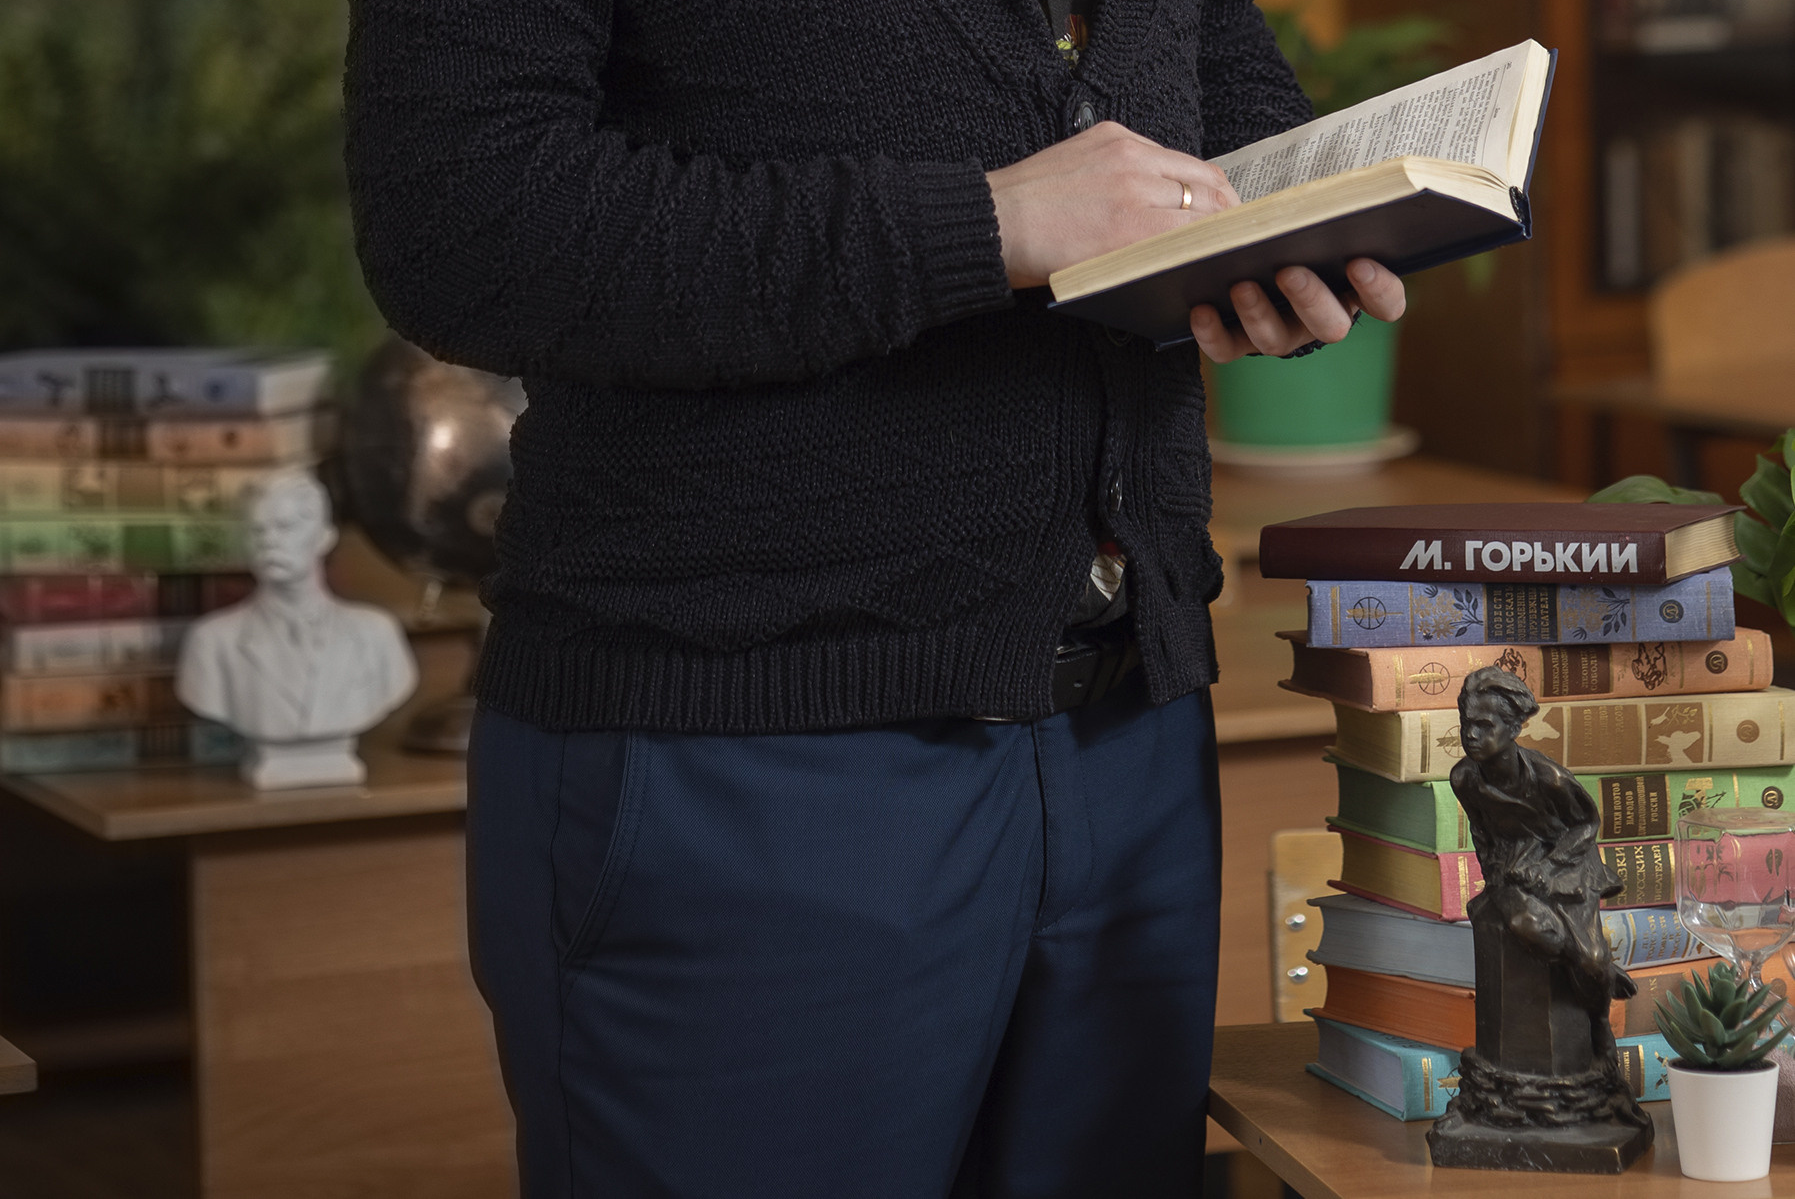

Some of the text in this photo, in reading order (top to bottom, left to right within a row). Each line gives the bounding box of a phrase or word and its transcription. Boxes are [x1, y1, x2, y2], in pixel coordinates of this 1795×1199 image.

[1399, 540, 1451, 570] М.
[1494, 589, 1503, 637] ПОВЕСТИ
[1612, 782, 1623, 835] СТИХИ ПОЭТОВ
[1626, 791, 1635, 826] НАРОДОВ
[1650, 792, 1659, 823] РОССИИ
[1615, 847, 1628, 906] СКЗКИ
[1635, 845, 1646, 905] РУССКИХ
